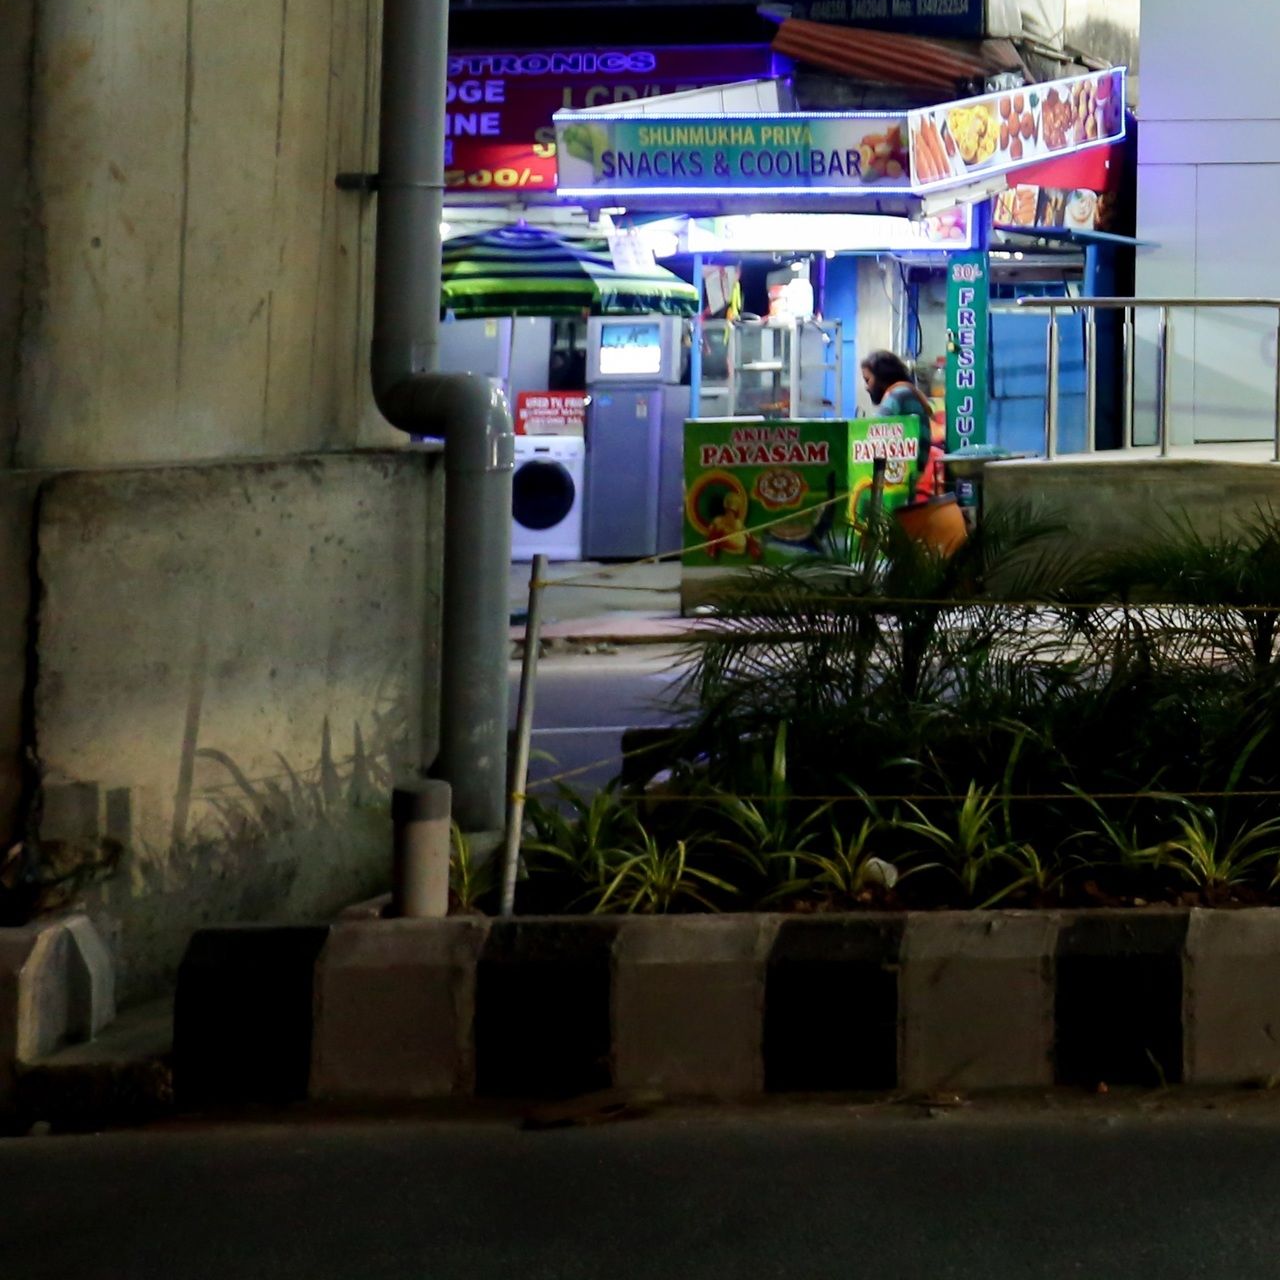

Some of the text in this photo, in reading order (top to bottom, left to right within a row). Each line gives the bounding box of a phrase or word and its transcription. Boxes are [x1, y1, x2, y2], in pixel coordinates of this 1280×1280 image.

[638, 125, 814, 146] SHUNMUKHA PRIYA
[601, 148, 863, 179] SNACKS & COOLBAR
[956, 287, 977, 389] FRESH
[732, 427, 799, 442] AKILAN
[701, 441, 829, 467] PAYASAM
[854, 438, 919, 462] PAYASAM
